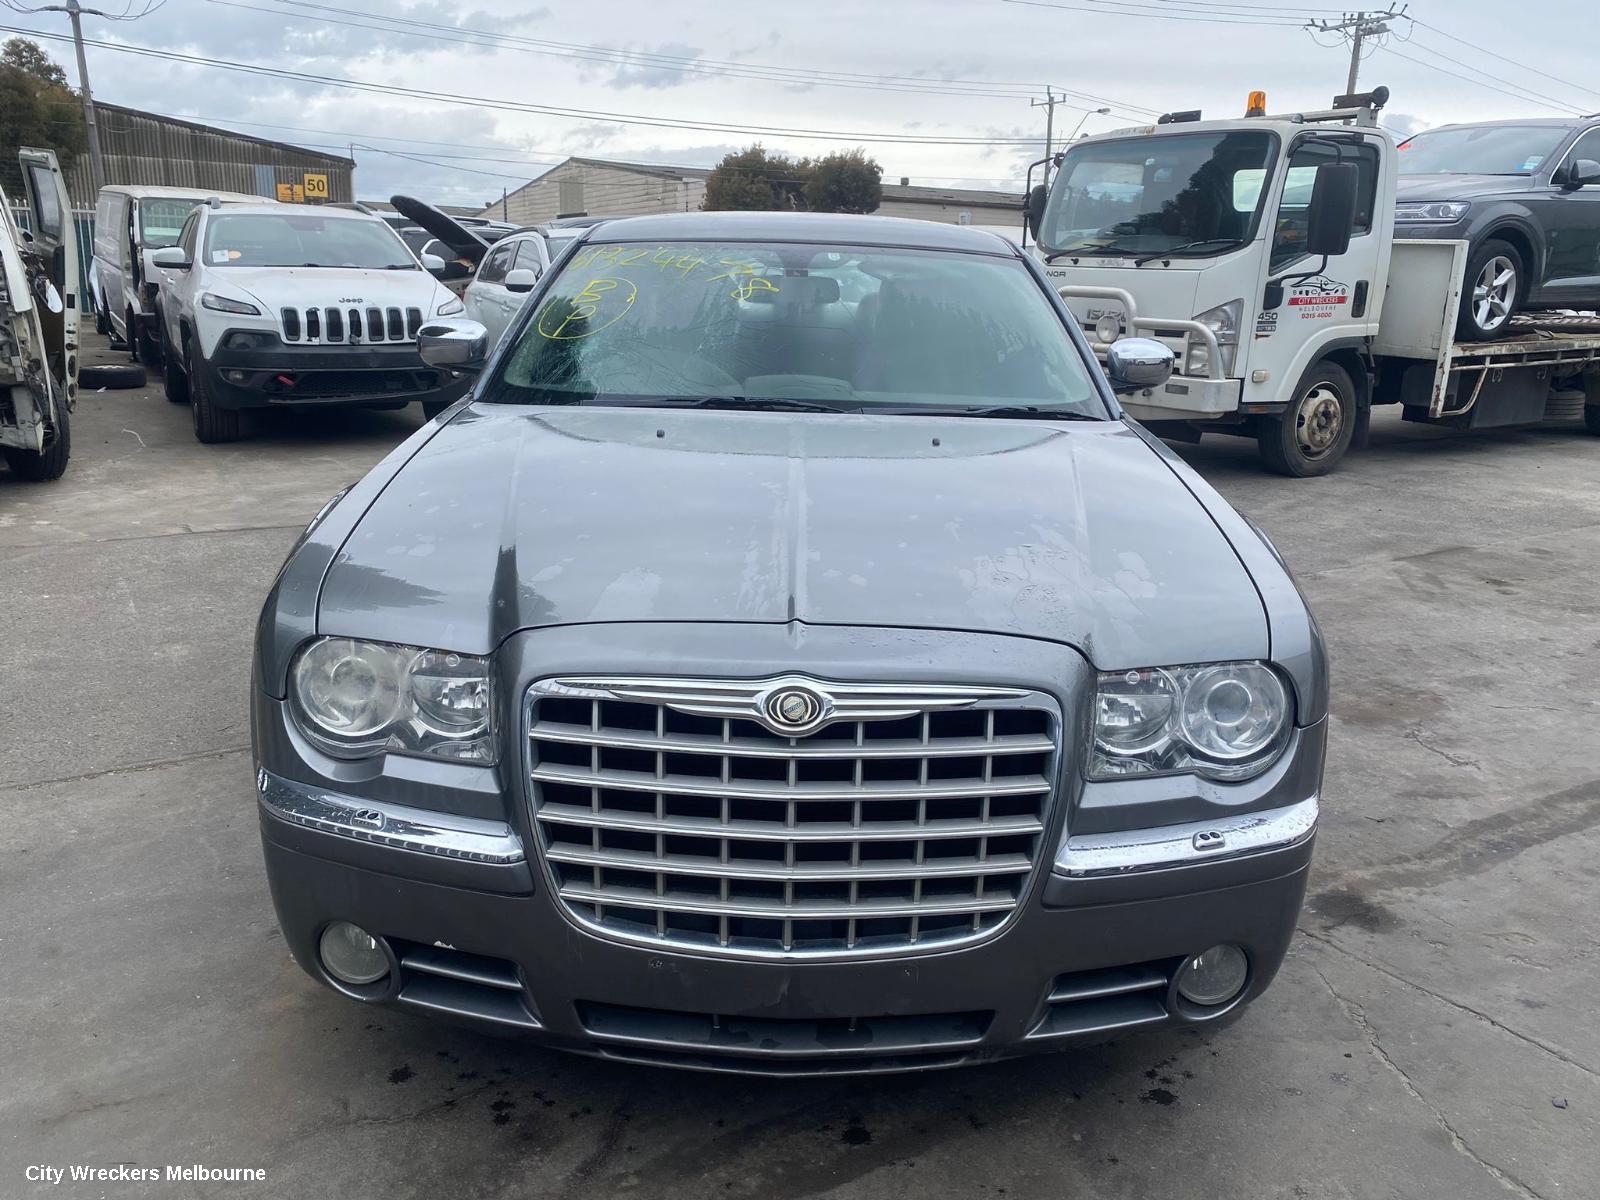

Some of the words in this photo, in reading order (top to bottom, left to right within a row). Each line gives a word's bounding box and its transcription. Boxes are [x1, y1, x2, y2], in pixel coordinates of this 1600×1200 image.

[307, 179, 325, 192] 50
[571, 279, 618, 305] B
[1298, 297, 1311, 305] CITY
[552, 305, 597, 338] P
[1258, 312, 1278, 320] 450
